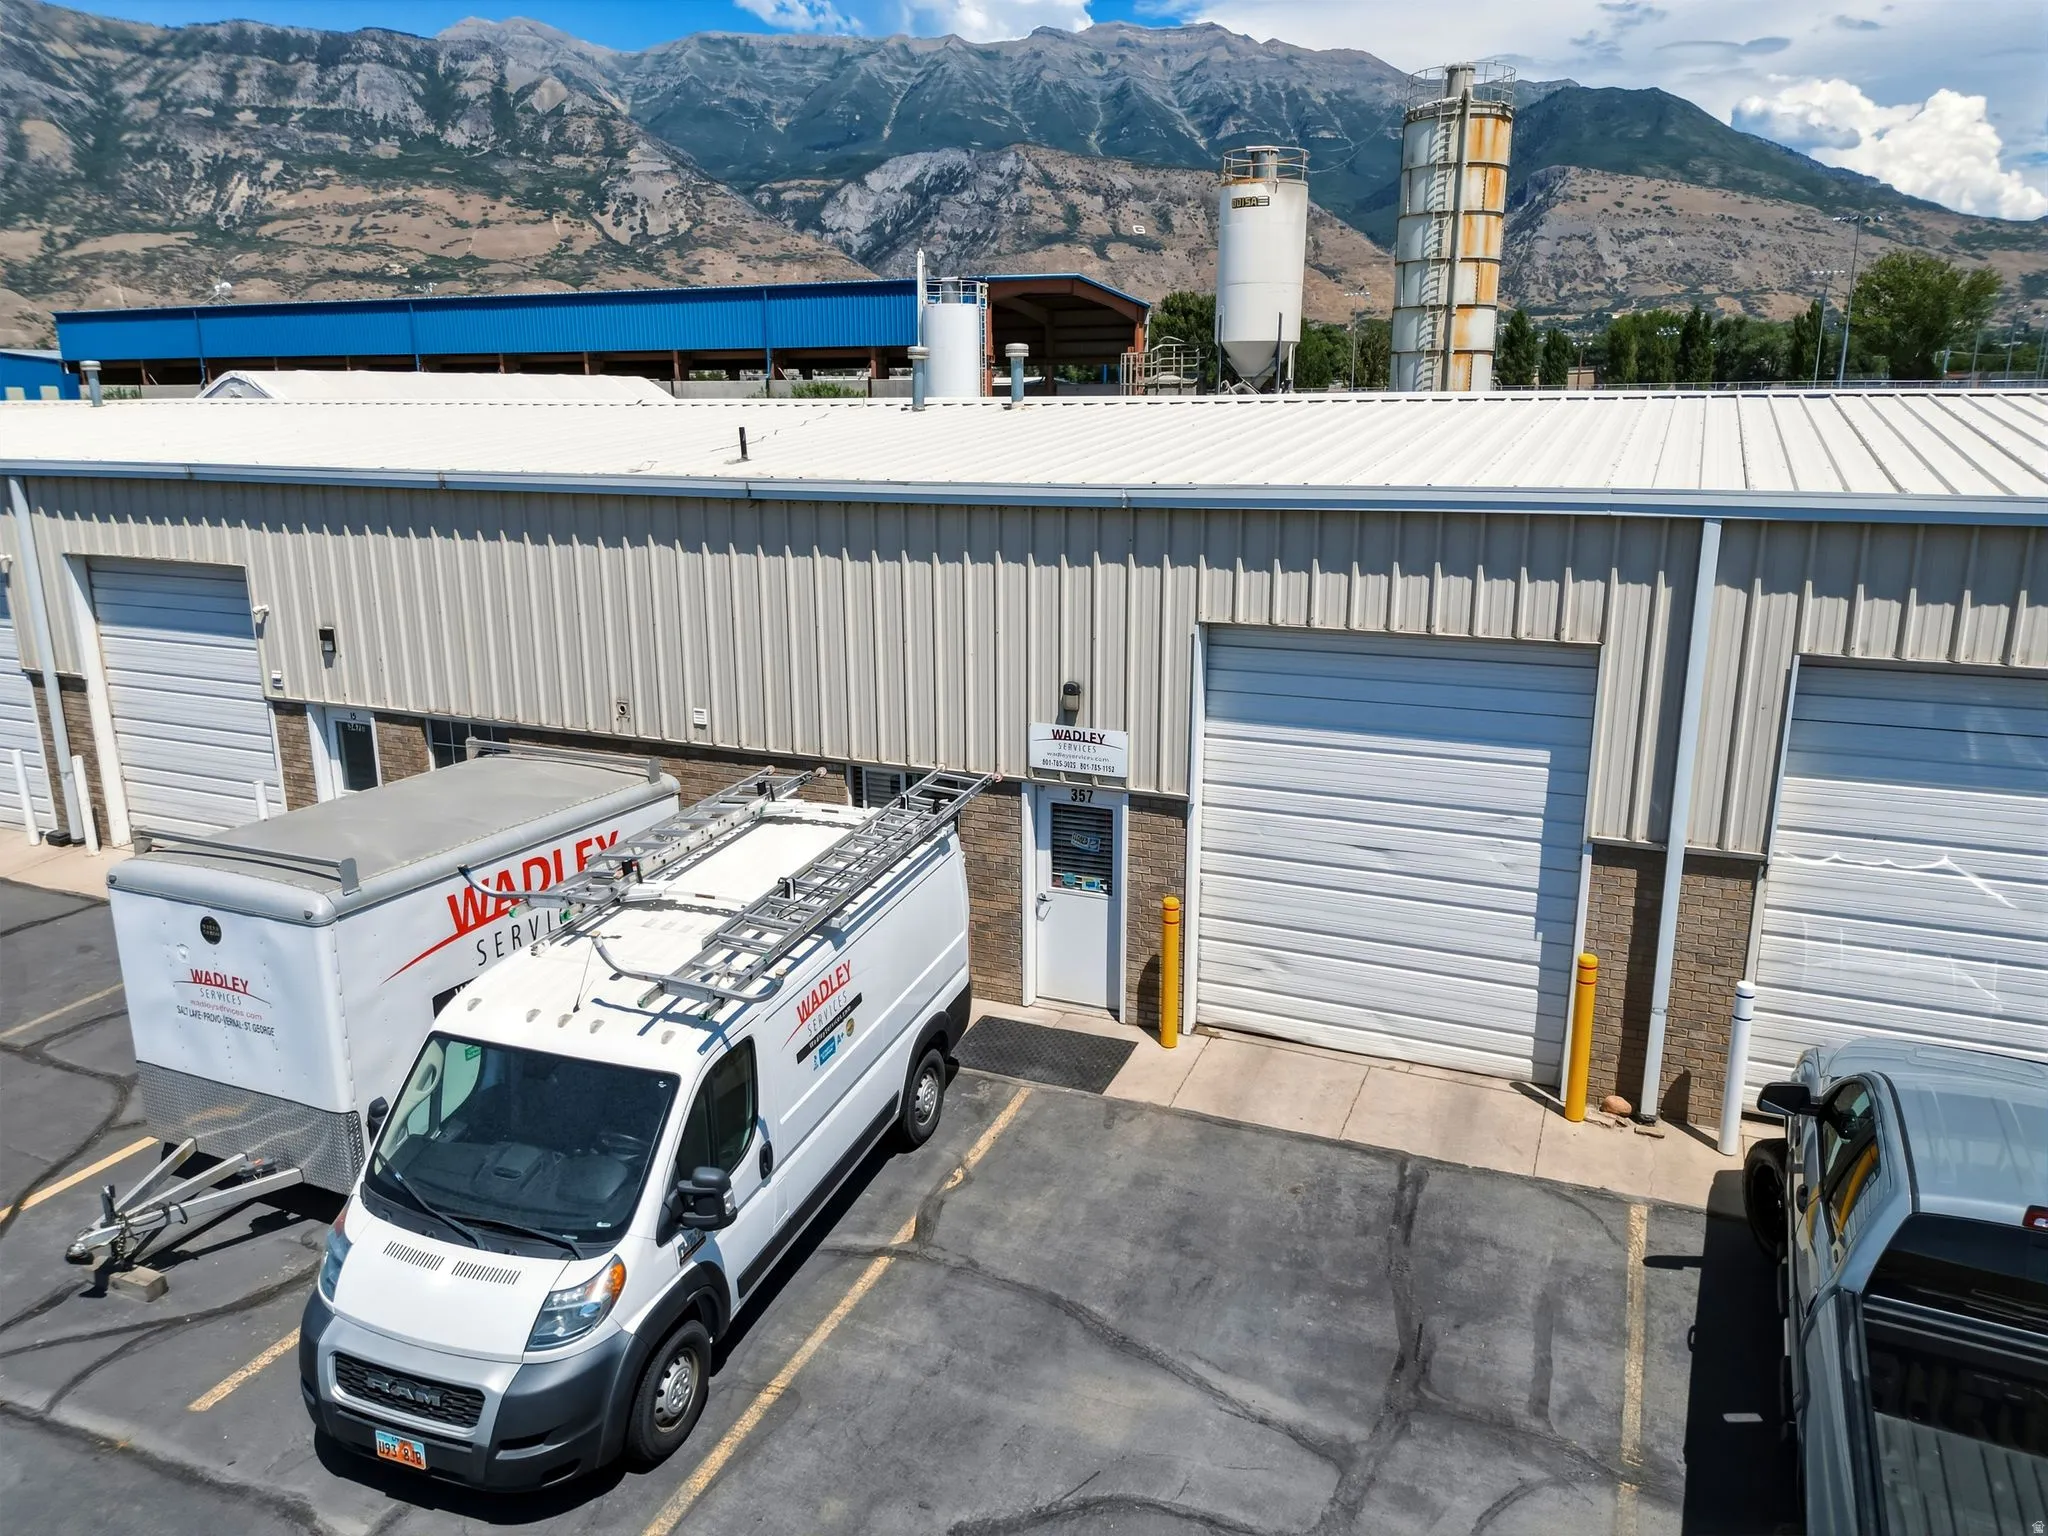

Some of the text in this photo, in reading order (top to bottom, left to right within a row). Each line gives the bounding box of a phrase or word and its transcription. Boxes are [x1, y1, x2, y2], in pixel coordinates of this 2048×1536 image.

[1051, 729, 1106, 745] WADLEY
[1058, 743, 1097, 754] SERVICES
[1071, 788, 1093, 804] 357
[190, 968, 249, 995] WADLEY
[199, 987, 242, 1006] SERVICES
[796, 959, 851, 1025] WADLEY
[807, 990, 847, 1038] SERVICES
